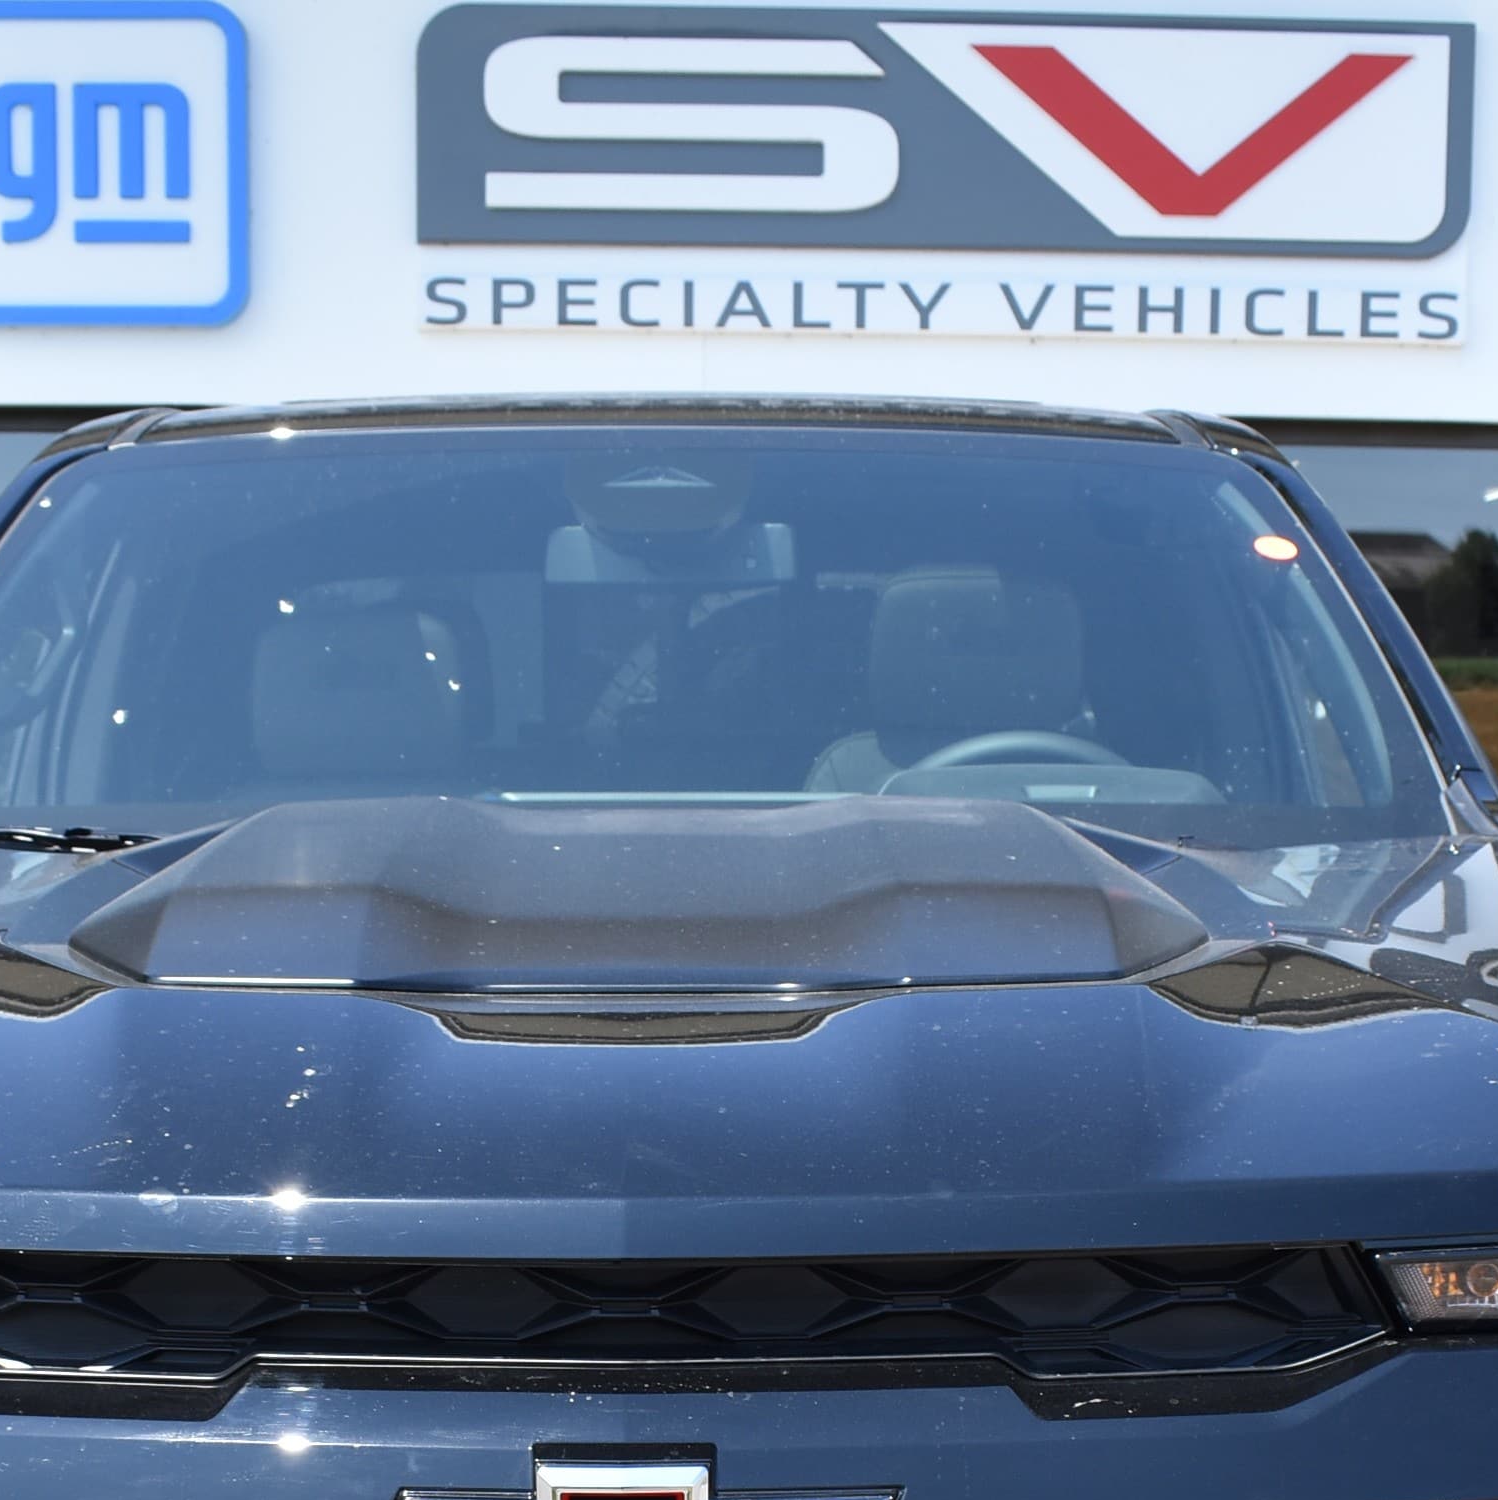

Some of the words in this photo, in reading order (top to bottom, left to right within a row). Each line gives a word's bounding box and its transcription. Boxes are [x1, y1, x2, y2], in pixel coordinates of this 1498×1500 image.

[483, 34, 1415, 218] SV
[424, 275, 953, 333] SPECIALTY
[1000, 283, 1458, 341] VEHICLES
